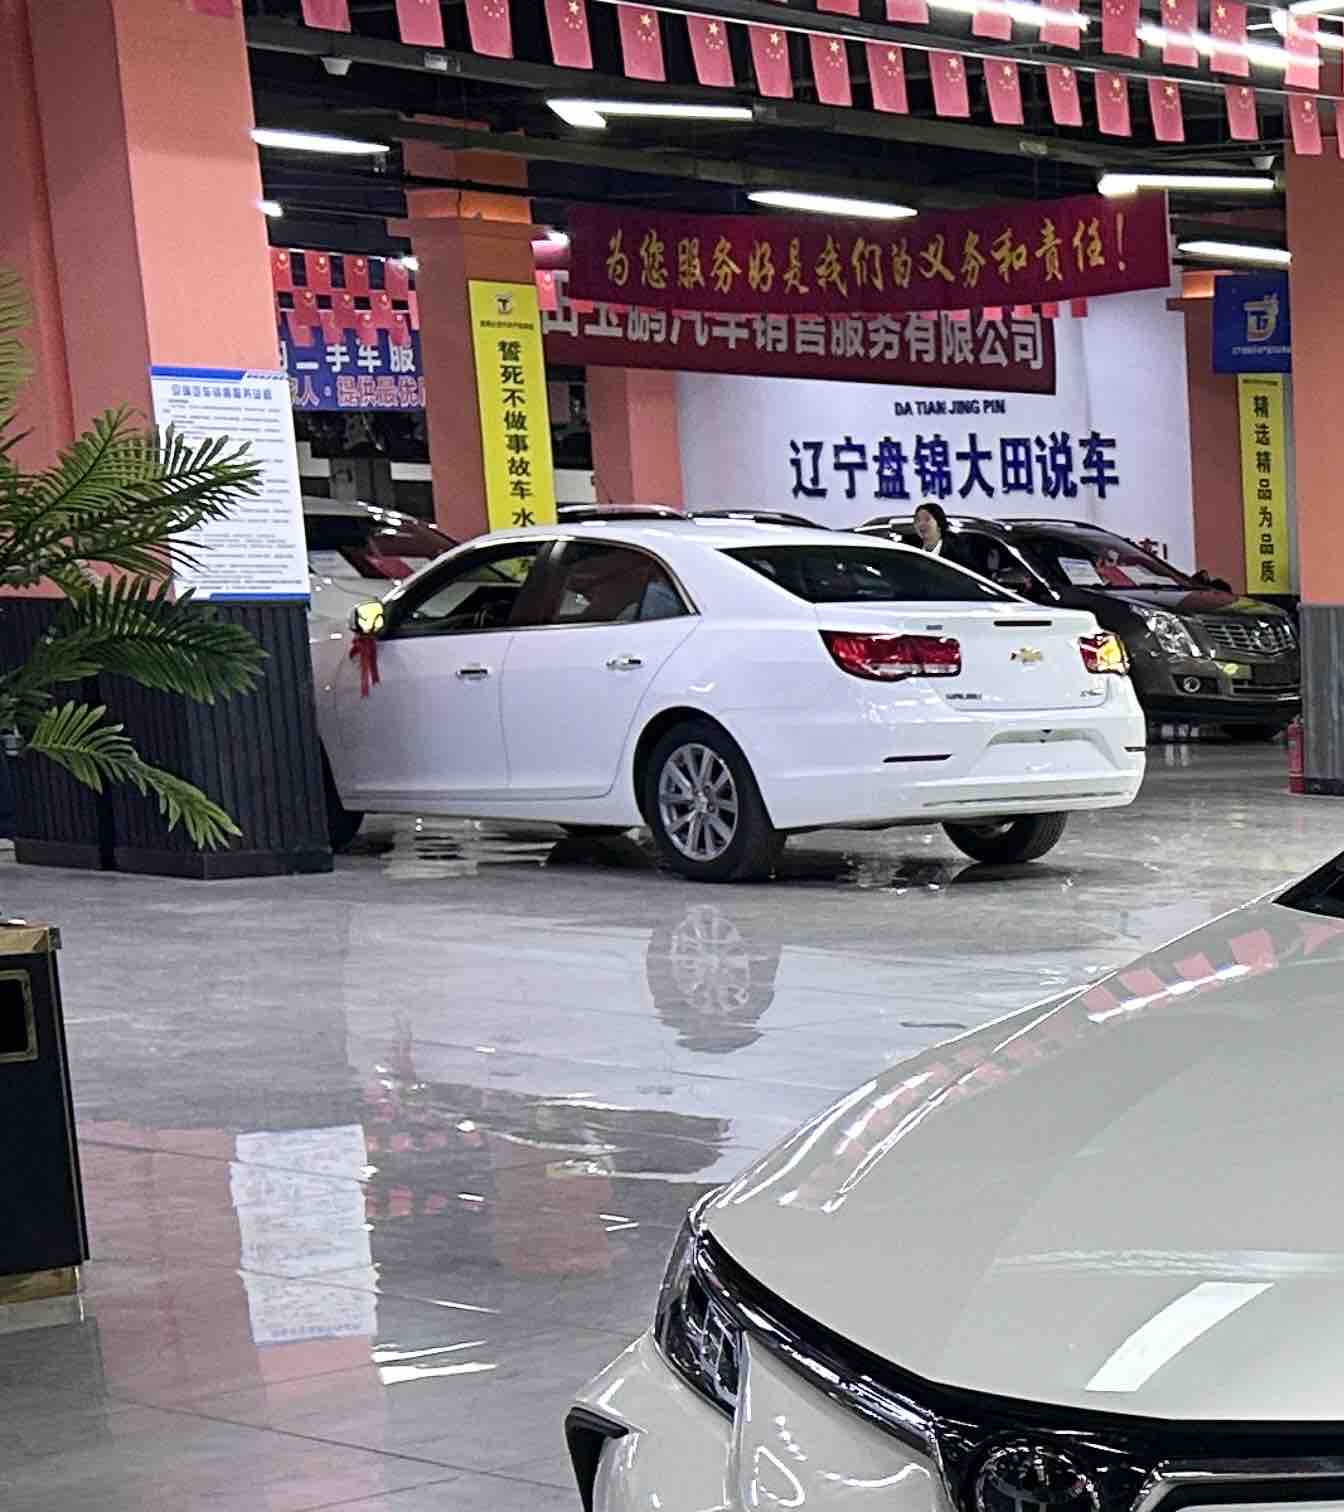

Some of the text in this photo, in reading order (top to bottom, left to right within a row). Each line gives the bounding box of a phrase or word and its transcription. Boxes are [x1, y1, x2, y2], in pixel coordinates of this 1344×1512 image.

[788, 431, 1120, 500] 辽宁盘锦大田说车
